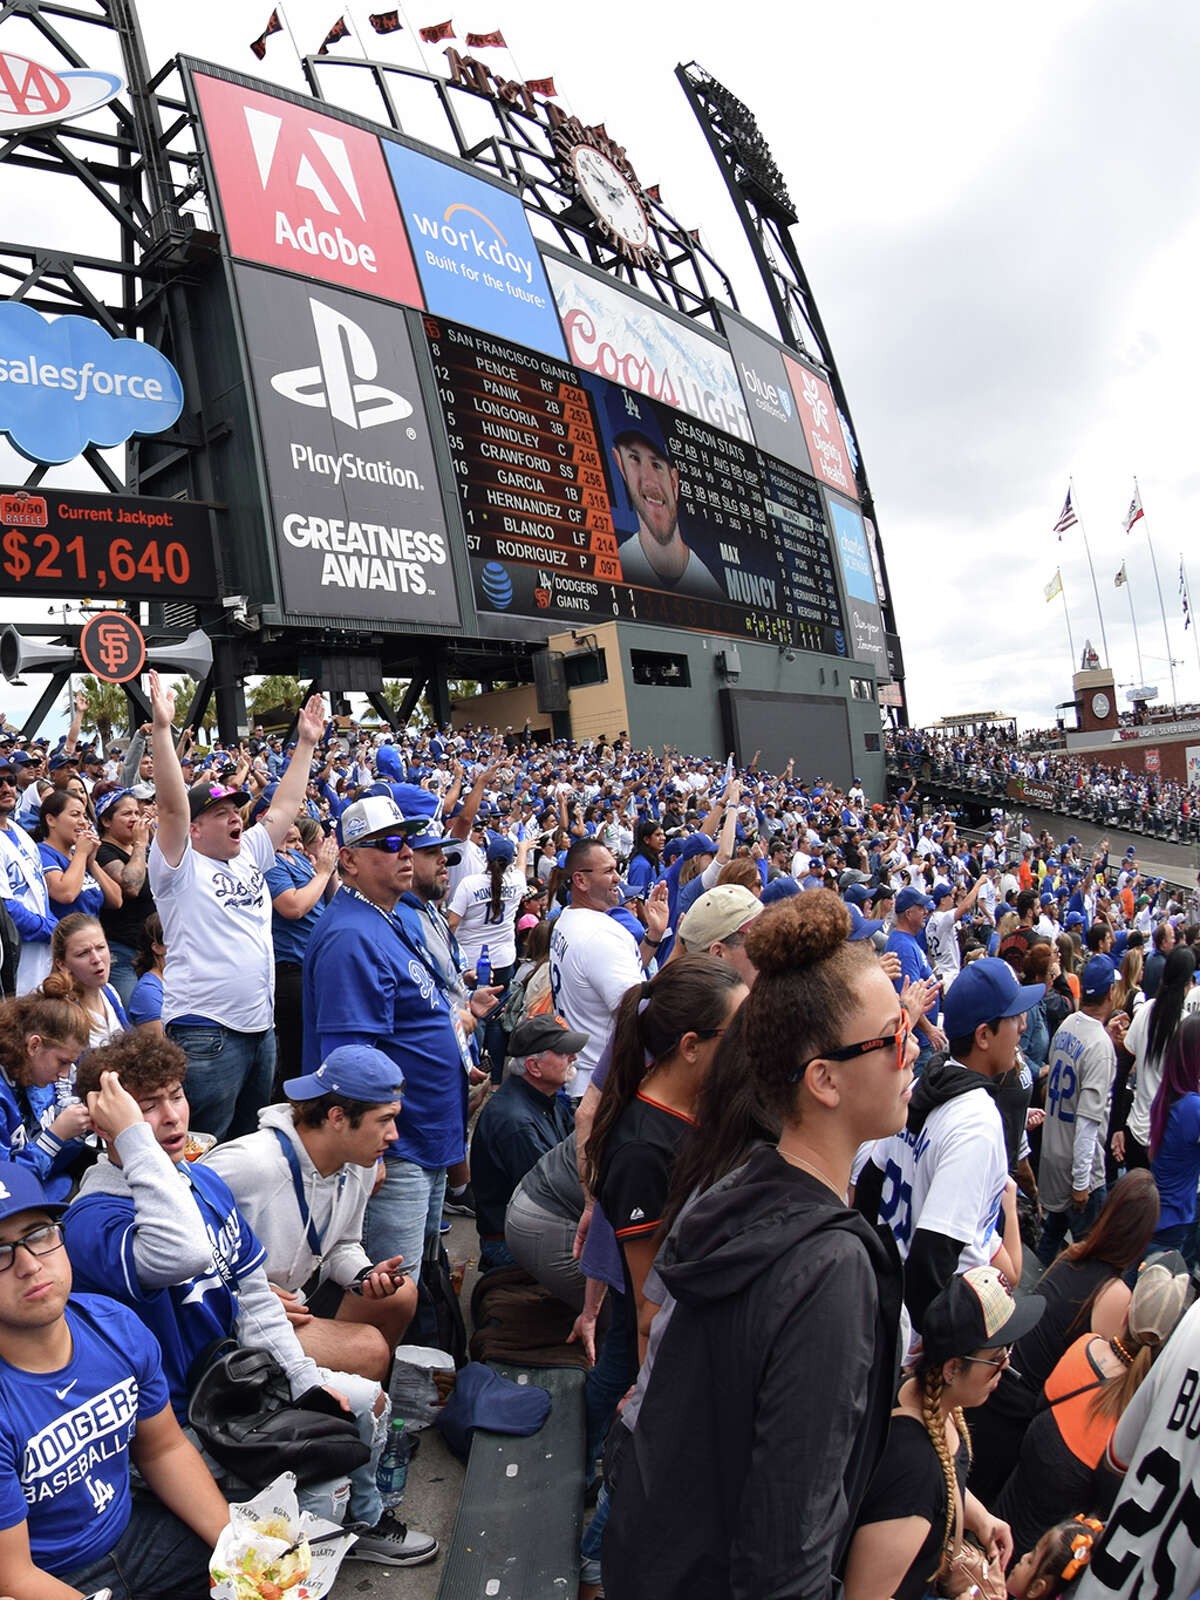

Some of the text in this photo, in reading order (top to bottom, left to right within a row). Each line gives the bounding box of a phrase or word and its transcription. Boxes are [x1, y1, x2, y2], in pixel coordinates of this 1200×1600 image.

[275, 211, 378, 274] Adobe
[412, 212, 533, 284] workday
[425, 251, 459, 274] Built
[460, 263, 481, 283] for
[483, 271, 505, 292] the
[432, 343, 440, 357] 8
[476, 356, 519, 382] PENCE
[540, 378, 554, 393] RF
[448, 329, 578, 385] SAN FRANCISCO GIANTS
[562, 308, 680, 407] Coors
[682, 375, 755, 446] LIGHT
[434, 365, 450, 381] 12
[483, 379, 521, 402] PANIK
[545, 400, 560, 415] 2B
[741, 363, 779, 405] blue
[440, 388, 455, 404] 10
[473, 398, 540, 428] LONGORIA
[550, 421, 565, 436] 3B
[447, 412, 566, 457] 5 HUNDLEY C
[669, 437, 682, 452] GP
[684, 444, 698, 459] AB
[713, 456, 730, 473] AVG
[674, 418, 745, 462] SEASON STATS
[449, 434, 574, 479] 35 CRAWFORD SS
[453, 459, 578, 501] 16 GARCIA 1B
[708, 490, 721, 505] HR
[721, 495, 739, 512] SLG
[4, 502, 42, 515] 50/50
[5, 514, 42, 525] RAFFLE
[58, 503, 174, 528] Current Jackpot:
[461, 484, 468, 499] 7
[486, 489, 562, 520] HERNANDEZ
[568, 509, 582, 523] CF
[282, 513, 447, 566] GREATNESS
[467, 510, 475, 524] 1
[503, 517, 555, 541] BLANCO
[573, 531, 586, 545] LF
[2, 529, 191, 588] $21,640
[467, 535, 481, 550] 57
[496, 540, 568, 567] RODRIGUEZ
[579, 554, 587, 568] P
[719, 542, 741, 565] MAX
[555, 576, 598, 596] DODGERS
[557, 595, 590, 612] GIANTS
[724, 567, 778, 610] MUNCY
[1023, 786, 1053, 801] GARDEN
[1048, 1058, 1077, 1123] 42
[212, 1248, 233, 1281] PANTO
[25, 1378, 140, 1477] DODGERS
[21, 1424, 137, 1504] BASEBALL
[84, 1476, 116, 1515] LA
